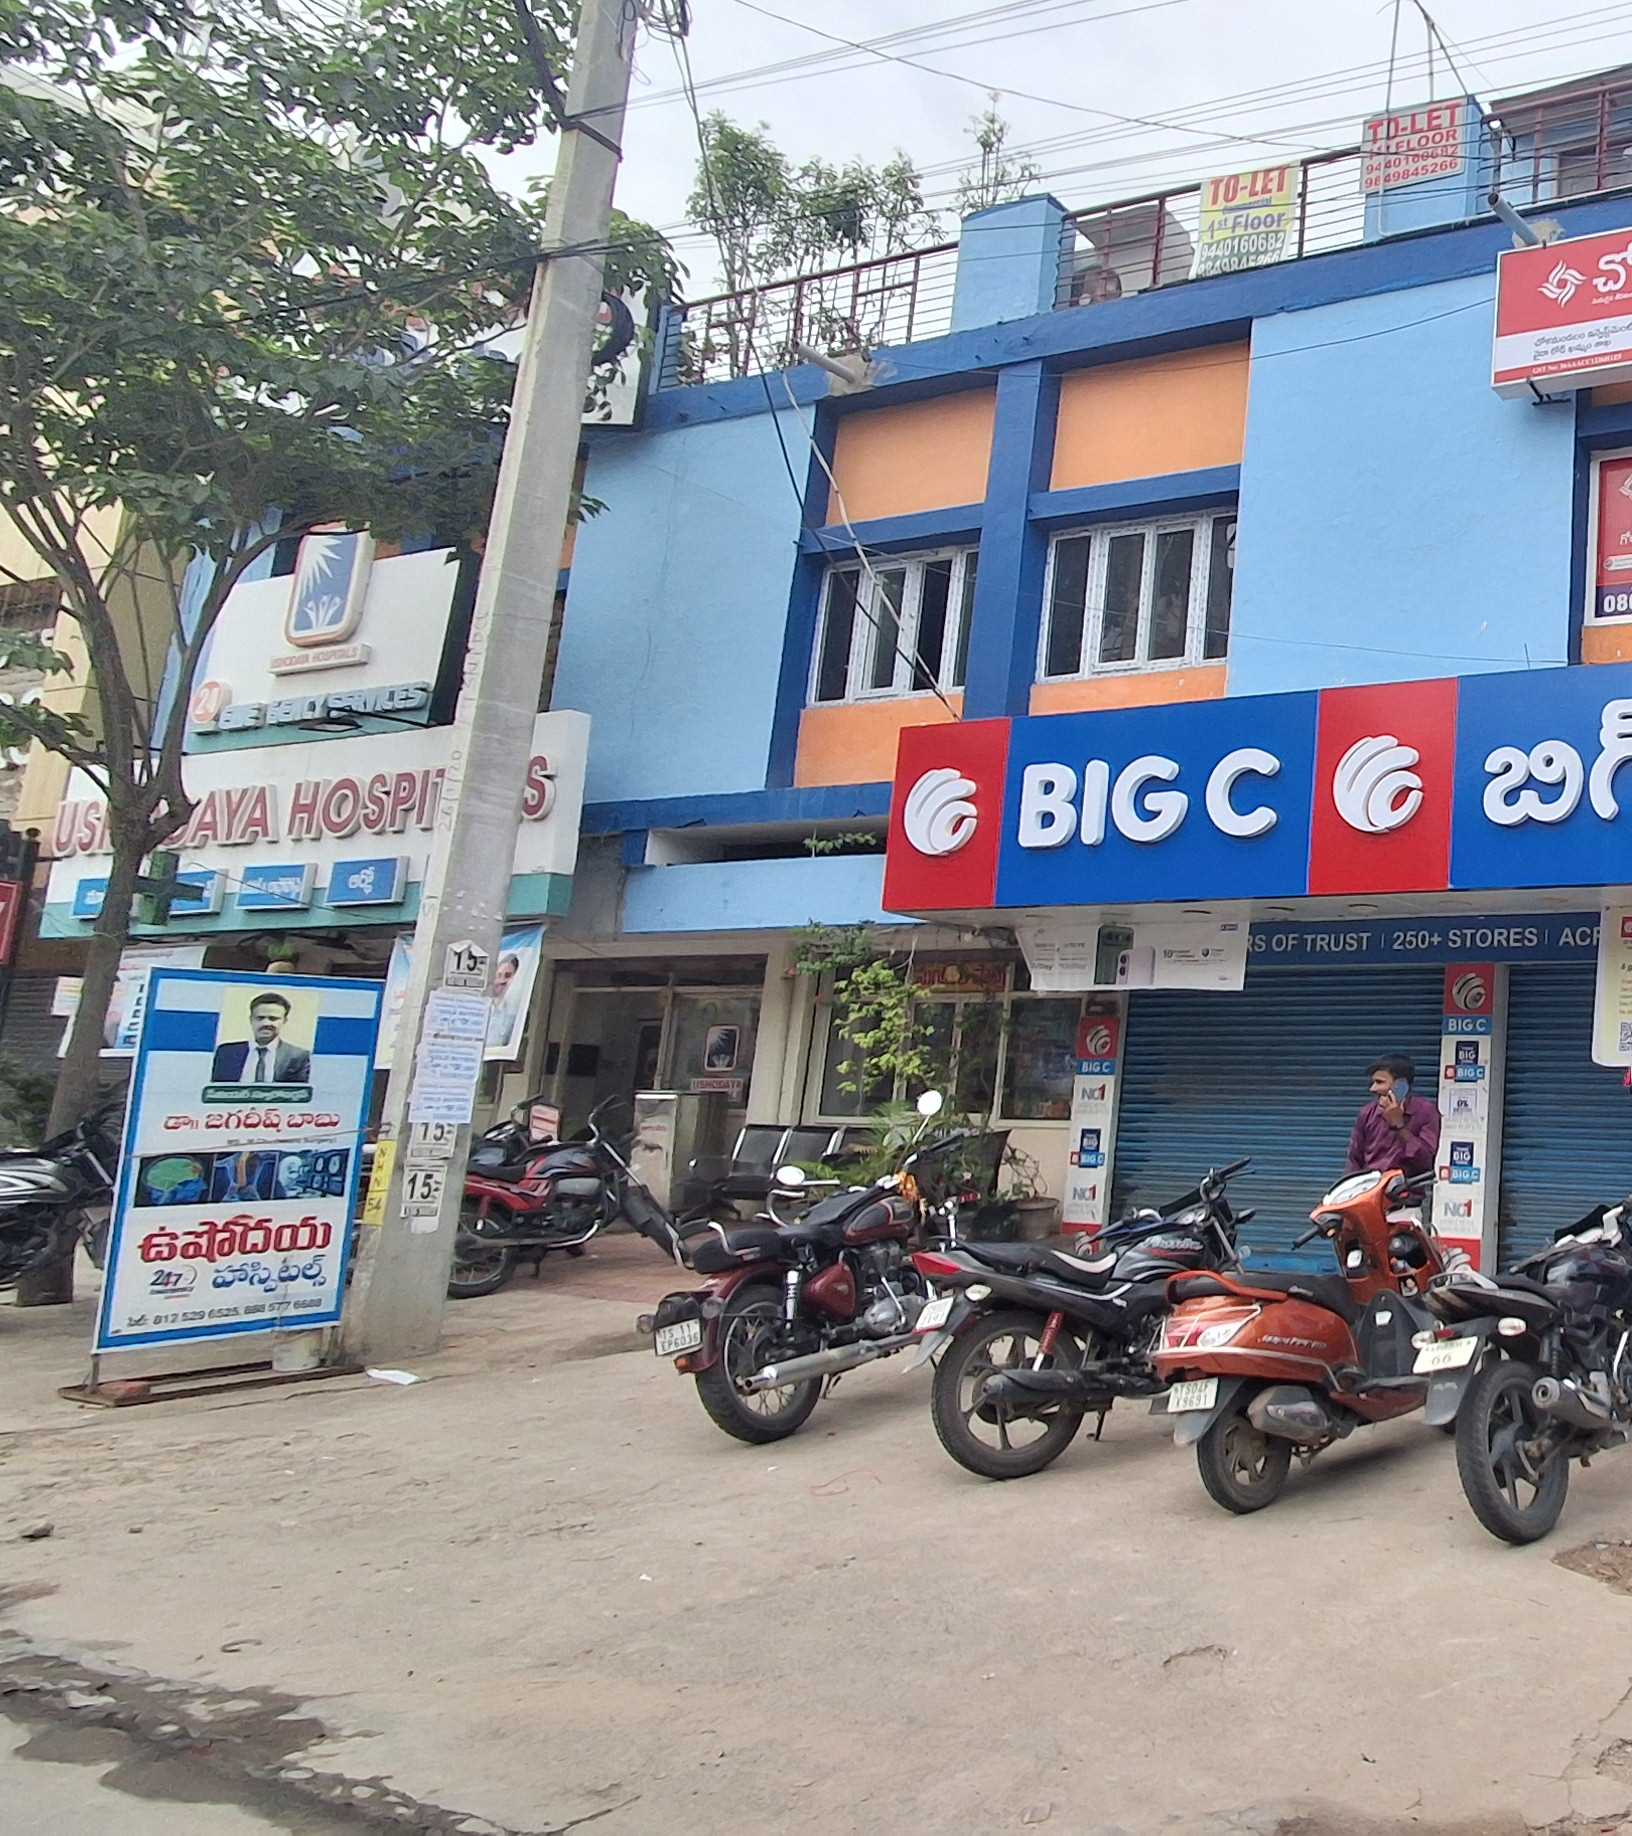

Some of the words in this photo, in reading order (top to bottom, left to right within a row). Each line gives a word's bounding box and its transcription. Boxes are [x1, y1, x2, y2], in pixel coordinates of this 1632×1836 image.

[1395, 129, 1457, 152] FLOOR
[1210, 166, 1287, 206] TO-LET
[1231, 212, 1286, 233] Floor
[288, 755, 553, 839] HOSPIS
[1017, 753, 1188, 849] BIG
[1206, 747, 1281, 838] C
[1272, 933, 1298, 951] OF
[1305, 932, 1372, 952] TRUST
[1392, 930, 1442, 950] 250+
[1448, 927, 1538, 948] STORES
[1448, 1018, 1474, 1032] BIG
[1476, 1018, 1488, 1032] C
[1458, 1050, 1476, 1061] BIG
[1082, 1060, 1101, 1073] BIG
[1102, 1061, 1111, 1073] C
[1457, 1067, 1475, 1078] BIG
[205, 1107, 282, 1132] జగదీష్
[287, 1111, 340, 1129] బాబు
[1453, 1151, 1471, 1162] BIG
[1452, 1169, 1470, 1180] BIG
[408, 1172, 434, 1200] 15
[138, 1213, 332, 1262] ఉషోదయ
